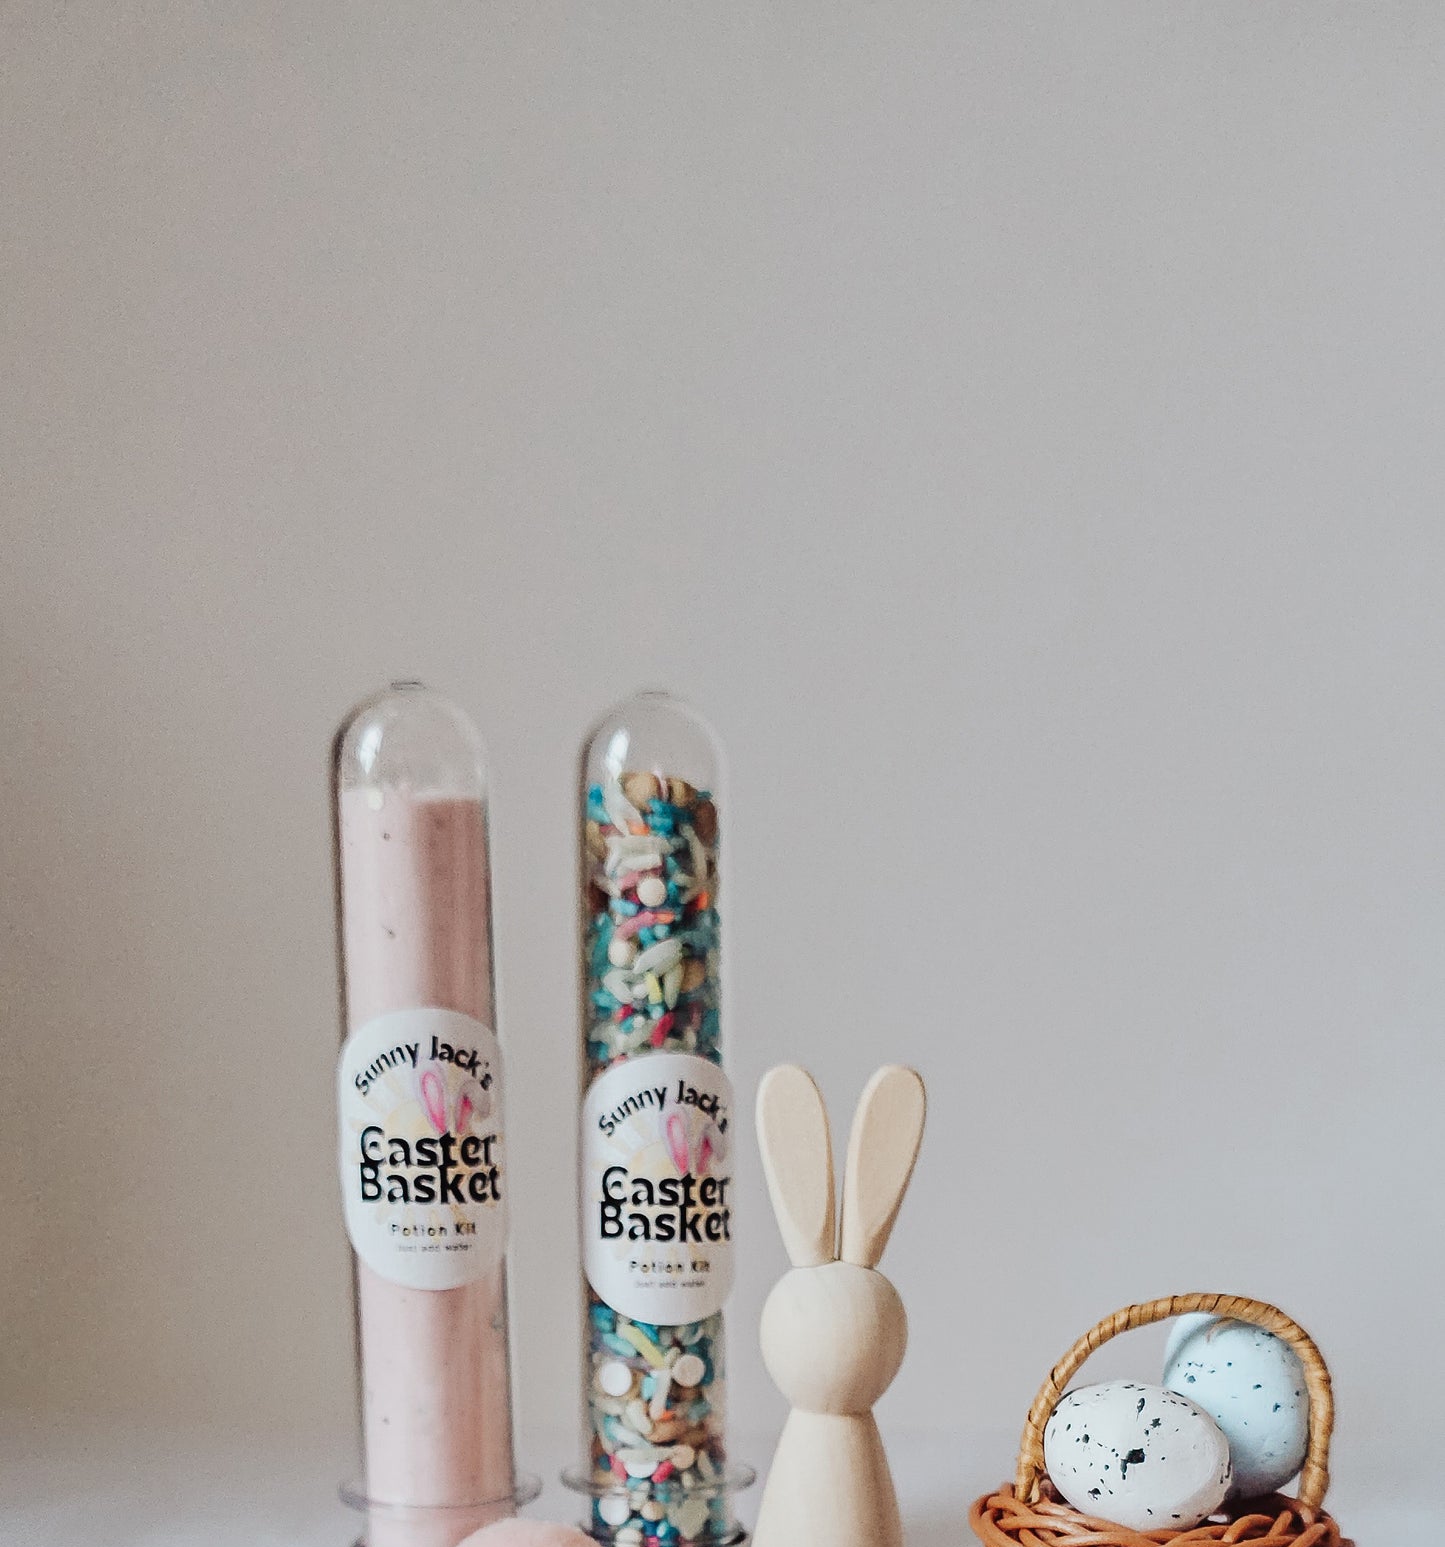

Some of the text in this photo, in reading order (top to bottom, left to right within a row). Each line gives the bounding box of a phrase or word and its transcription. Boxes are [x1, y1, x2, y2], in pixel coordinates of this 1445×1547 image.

[355, 1035, 492, 1097] Sunny Jack's
[599, 1087, 667, 1137] Sunny
[360, 1125, 496, 1168] Easter
[360, 1161, 501, 1204] Basket
[602, 1166, 729, 1208] Easter
[391, 1223, 447, 1236] Potion
[600, 1200, 730, 1242] Basket
[629, 1260, 683, 1273] Potion
